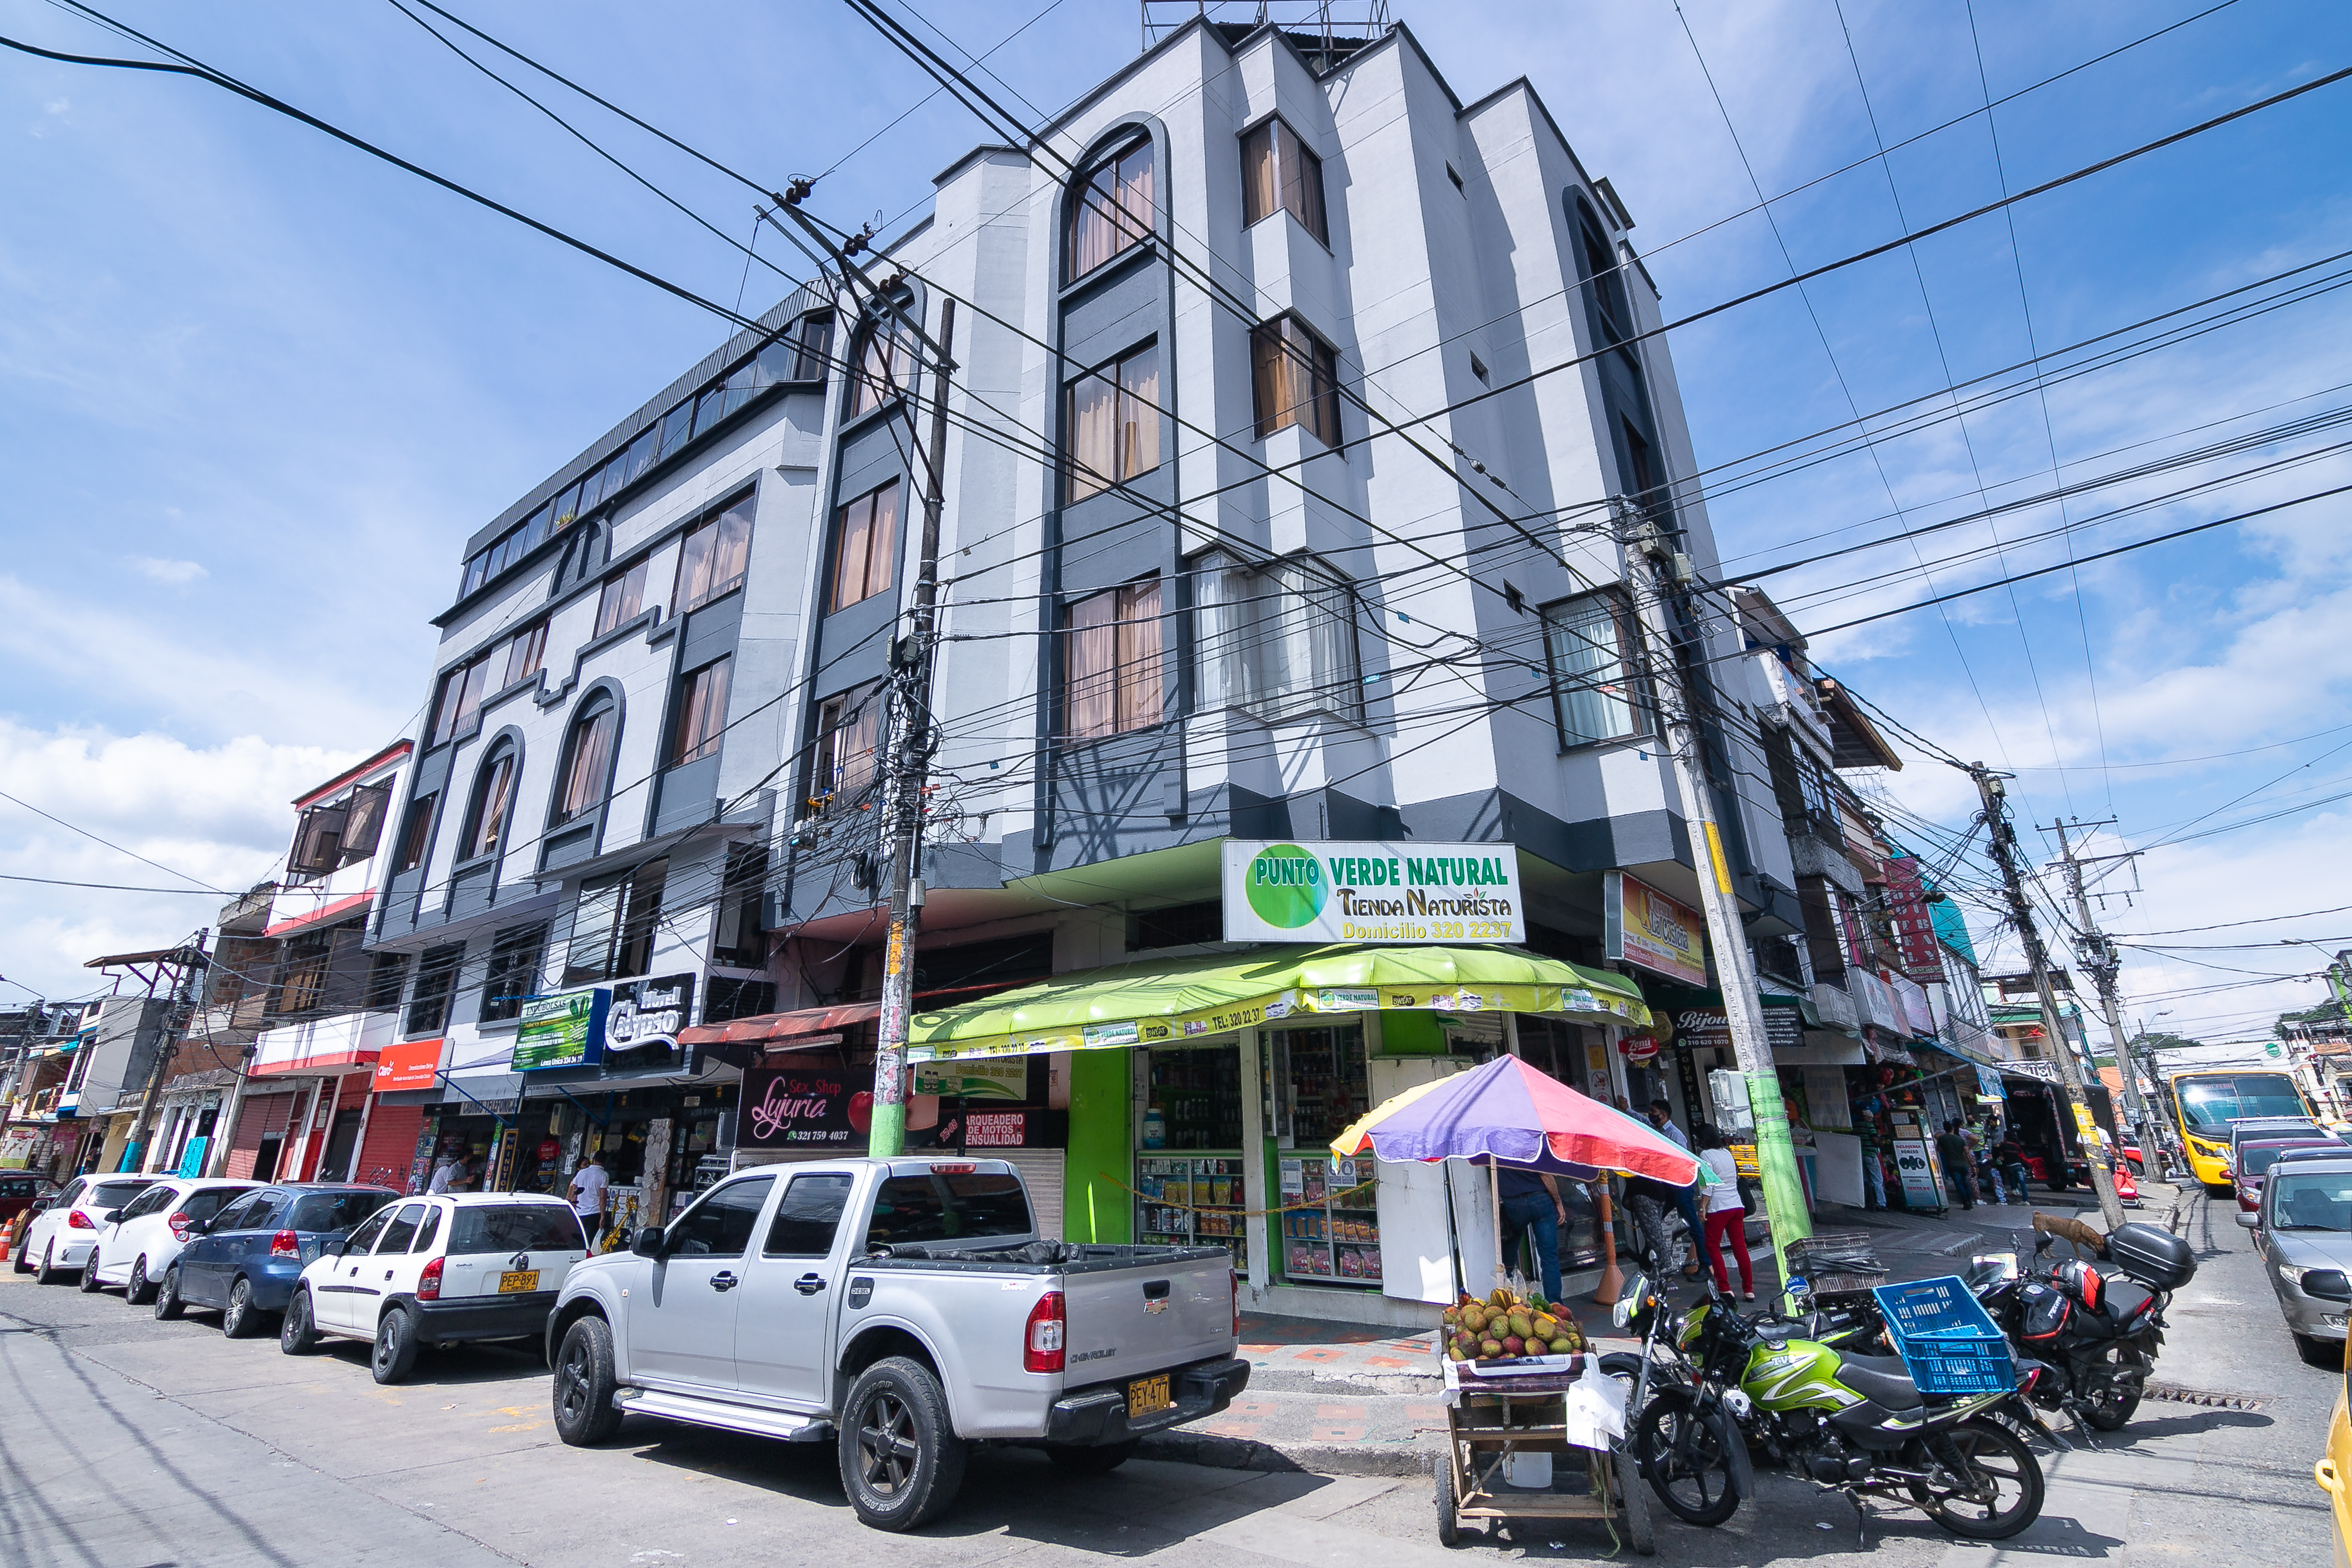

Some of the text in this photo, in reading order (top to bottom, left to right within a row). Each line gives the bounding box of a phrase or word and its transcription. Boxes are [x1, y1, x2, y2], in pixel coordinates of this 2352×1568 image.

[1256, 857, 1508, 886] PUNTO VERDE NATURAL
[1337, 889, 1512, 916] TIENDA NATURISTA
[1343, 922, 1512, 939] Domicilio 320 2237
[1651, 912, 1661, 936] La
[1662, 918, 1688, 951] Costeña
[526, 1000, 566, 1016] INDUBOLSAS
[1212, 1016, 1228, 1030] TEL:
[1229, 1012, 1242, 1025] 320
[1243, 1010, 1251, 1024] 22
[1252, 1008, 1260, 1022] 37
[1677, 1011, 1729, 1032] Bijou
[1147, 1027, 1165, 1037] SWEAT
[1629, 1038, 1651, 1051] Zenú
[378, 1065, 392, 1076] Claro
[956, 1063, 1024, 1078] Domicilio 320 2237
[790, 1079, 841, 1097] Sex Shop
[752, 1076, 827, 1139] Lujuria
[966, 1114, 1023, 1126] ARQUEADERO
[797, 1131, 849, 1140] 321 759 4037
[940, 1119, 958, 1142] 72-08
[982, 1125, 1013, 1134] MOTOS
[966, 1134, 1023, 1145] ENSUALIDAD
[542, 1161, 554, 1169] tigo
[1070, 1348, 1117, 1363] CHEVROLET
[1771, 1354, 1796, 1367] TVS
[853, 1381, 893, 1414] DUNLOP
